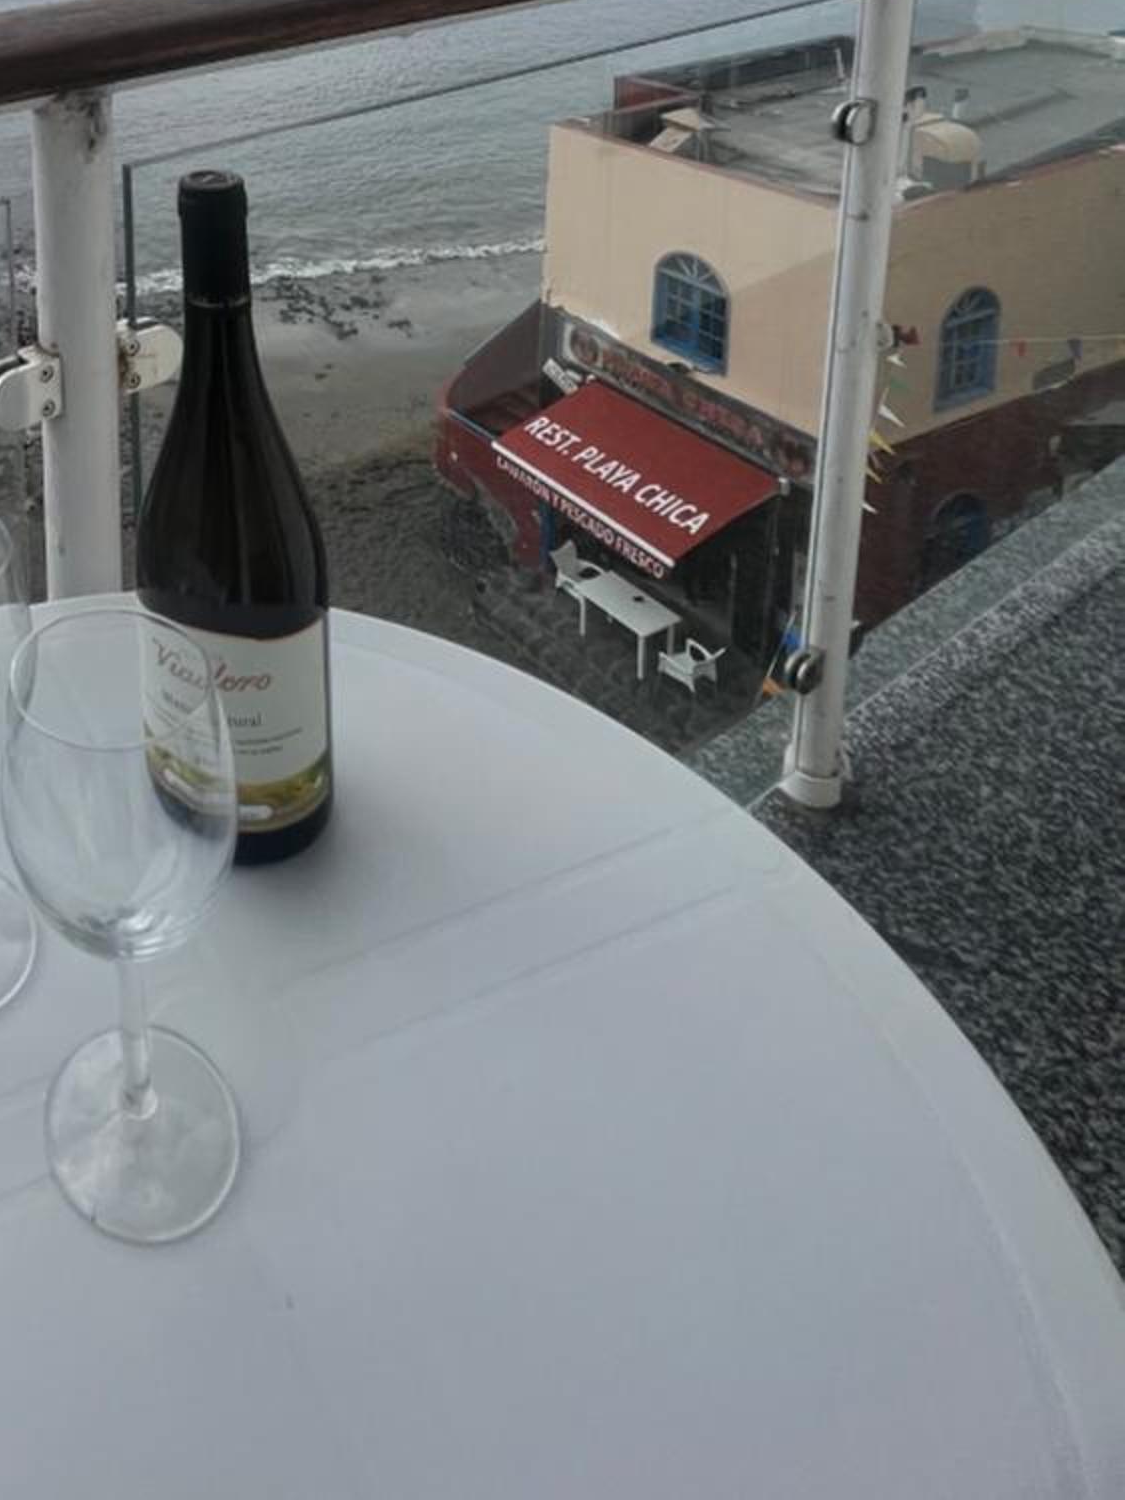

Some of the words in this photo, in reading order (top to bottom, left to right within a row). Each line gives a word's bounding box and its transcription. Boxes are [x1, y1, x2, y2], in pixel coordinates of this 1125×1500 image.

[523, 415, 583, 455] REST.
[570, 444, 642, 494] PLAYA
[633, 483, 711, 536] CHICA
